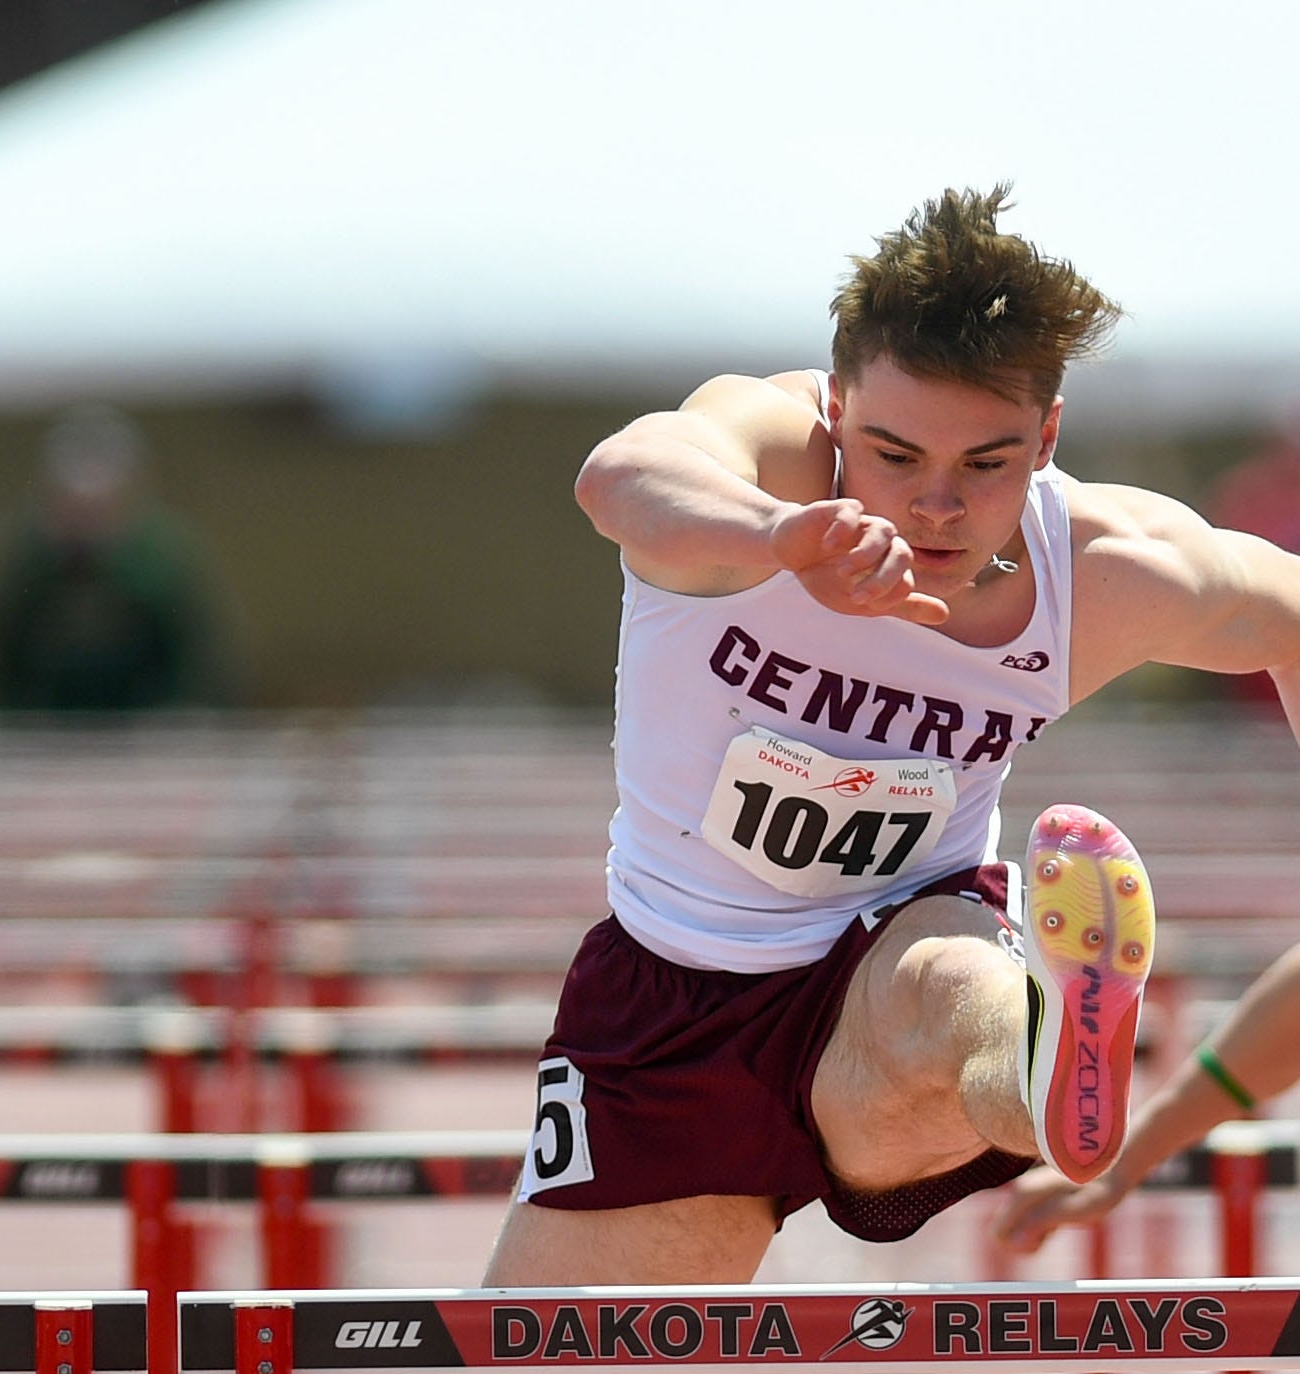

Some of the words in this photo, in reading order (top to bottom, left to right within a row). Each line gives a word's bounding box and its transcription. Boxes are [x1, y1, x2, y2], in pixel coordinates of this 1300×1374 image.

[757, 749, 811, 780] DAKOTA
[888, 784, 934, 797] RELAYS
[767, 737, 813, 766] Howard
[898, 768, 929, 782] Wood
[731, 778, 932, 877] 1047
[533, 1065, 574, 1180] 5
[1077, 1039, 1101, 1152] ZOOM
[334, 1321, 423, 1348] GILL
[491, 1303, 803, 1360] DAKOTA
[933, 1297, 1228, 1355] RELAYS
